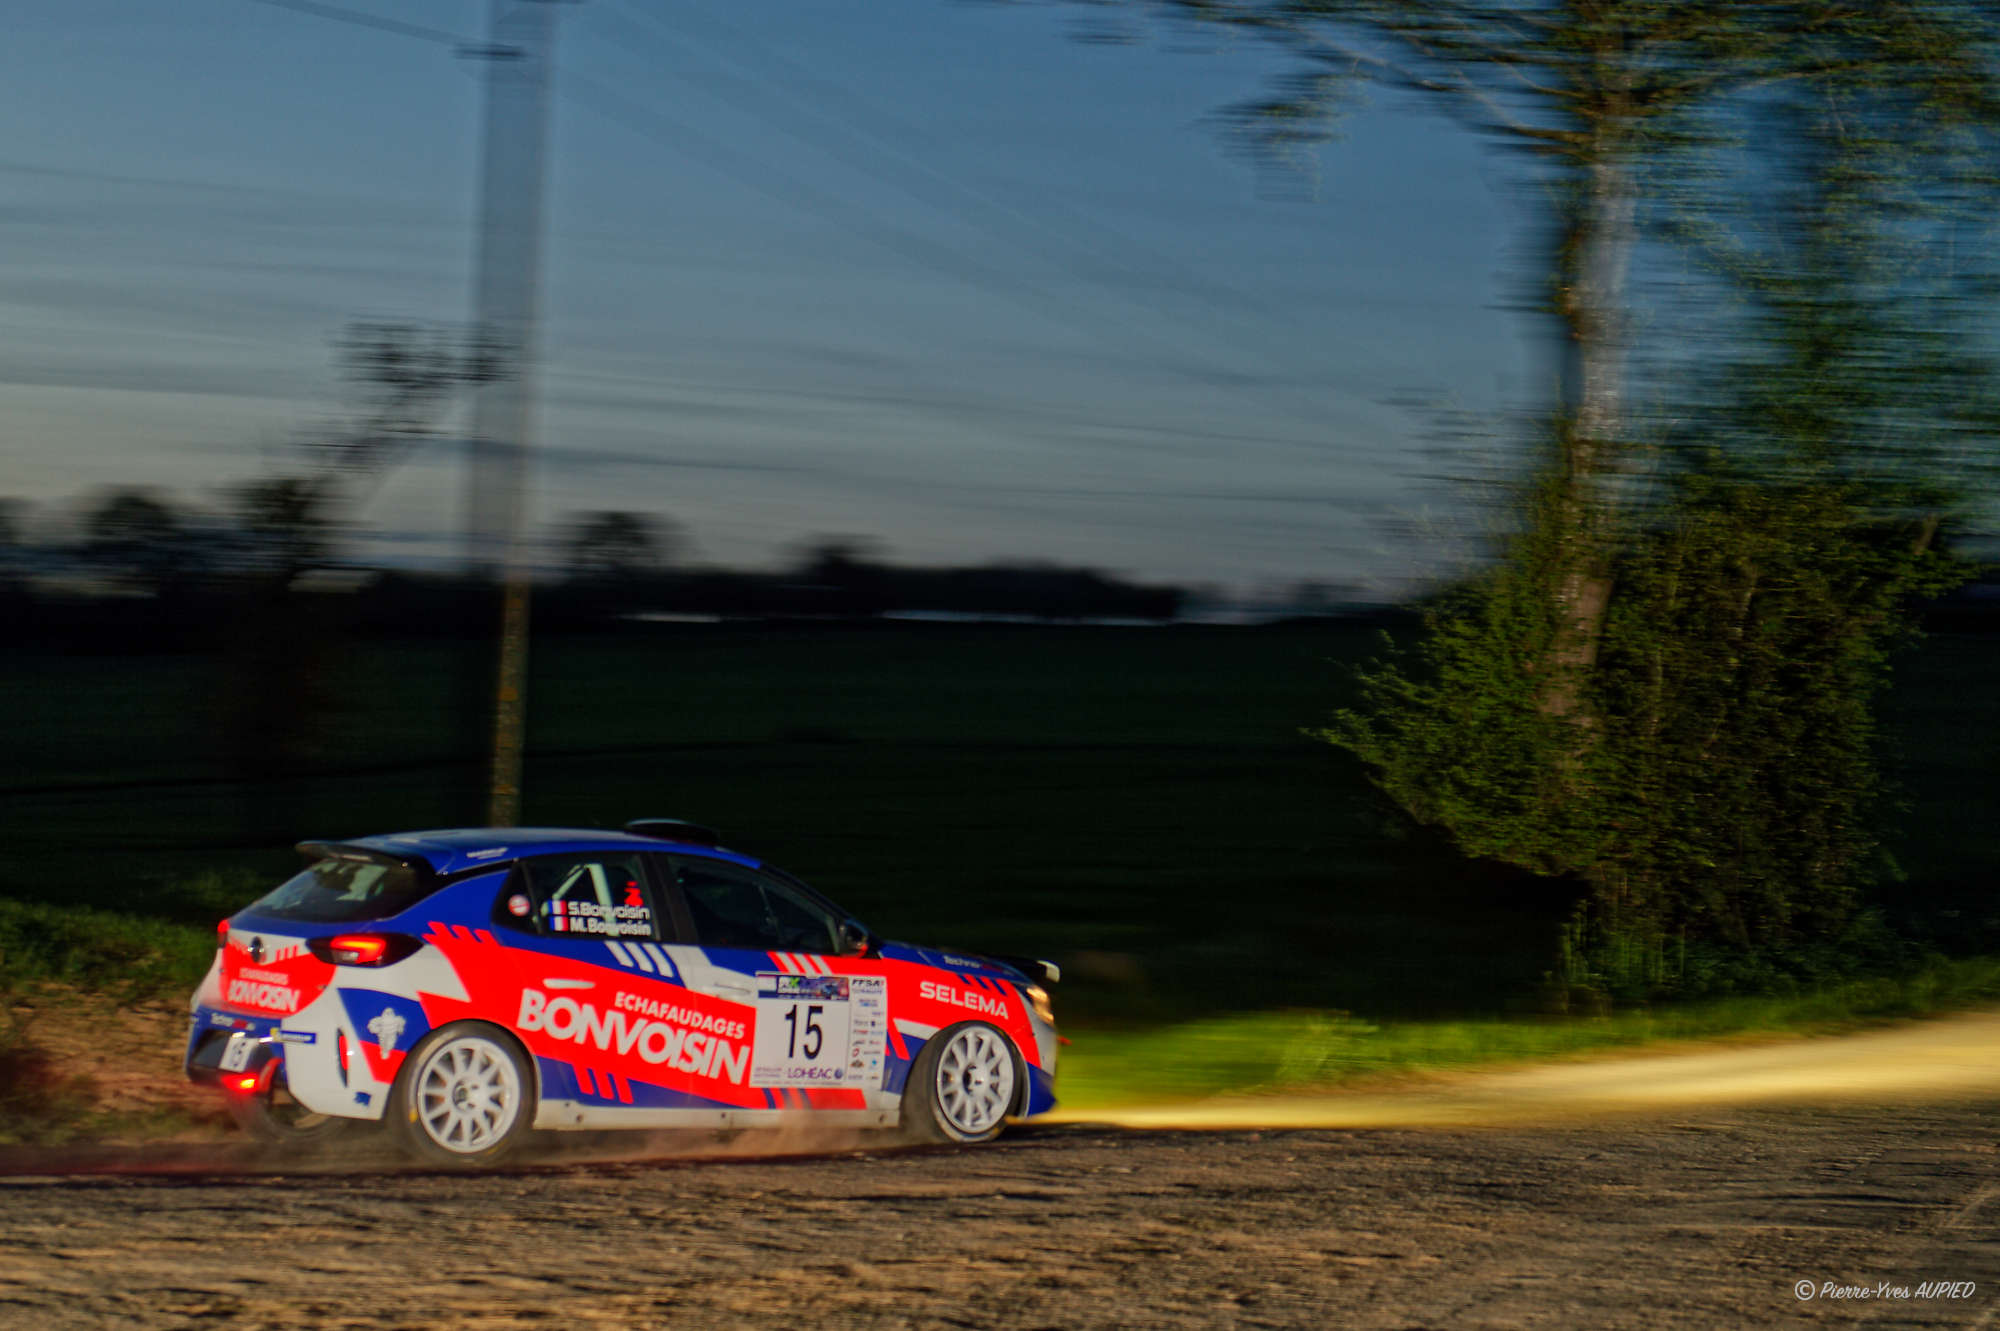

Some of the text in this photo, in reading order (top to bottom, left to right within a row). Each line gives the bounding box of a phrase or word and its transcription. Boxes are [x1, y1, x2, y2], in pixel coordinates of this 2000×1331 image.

[614, 991, 745, 1039] ECHAFAUDAGES
[920, 981, 1009, 1020] SELEMA
[516, 987, 750, 1085] BONVOISIN
[785, 1004, 823, 1060] 15
